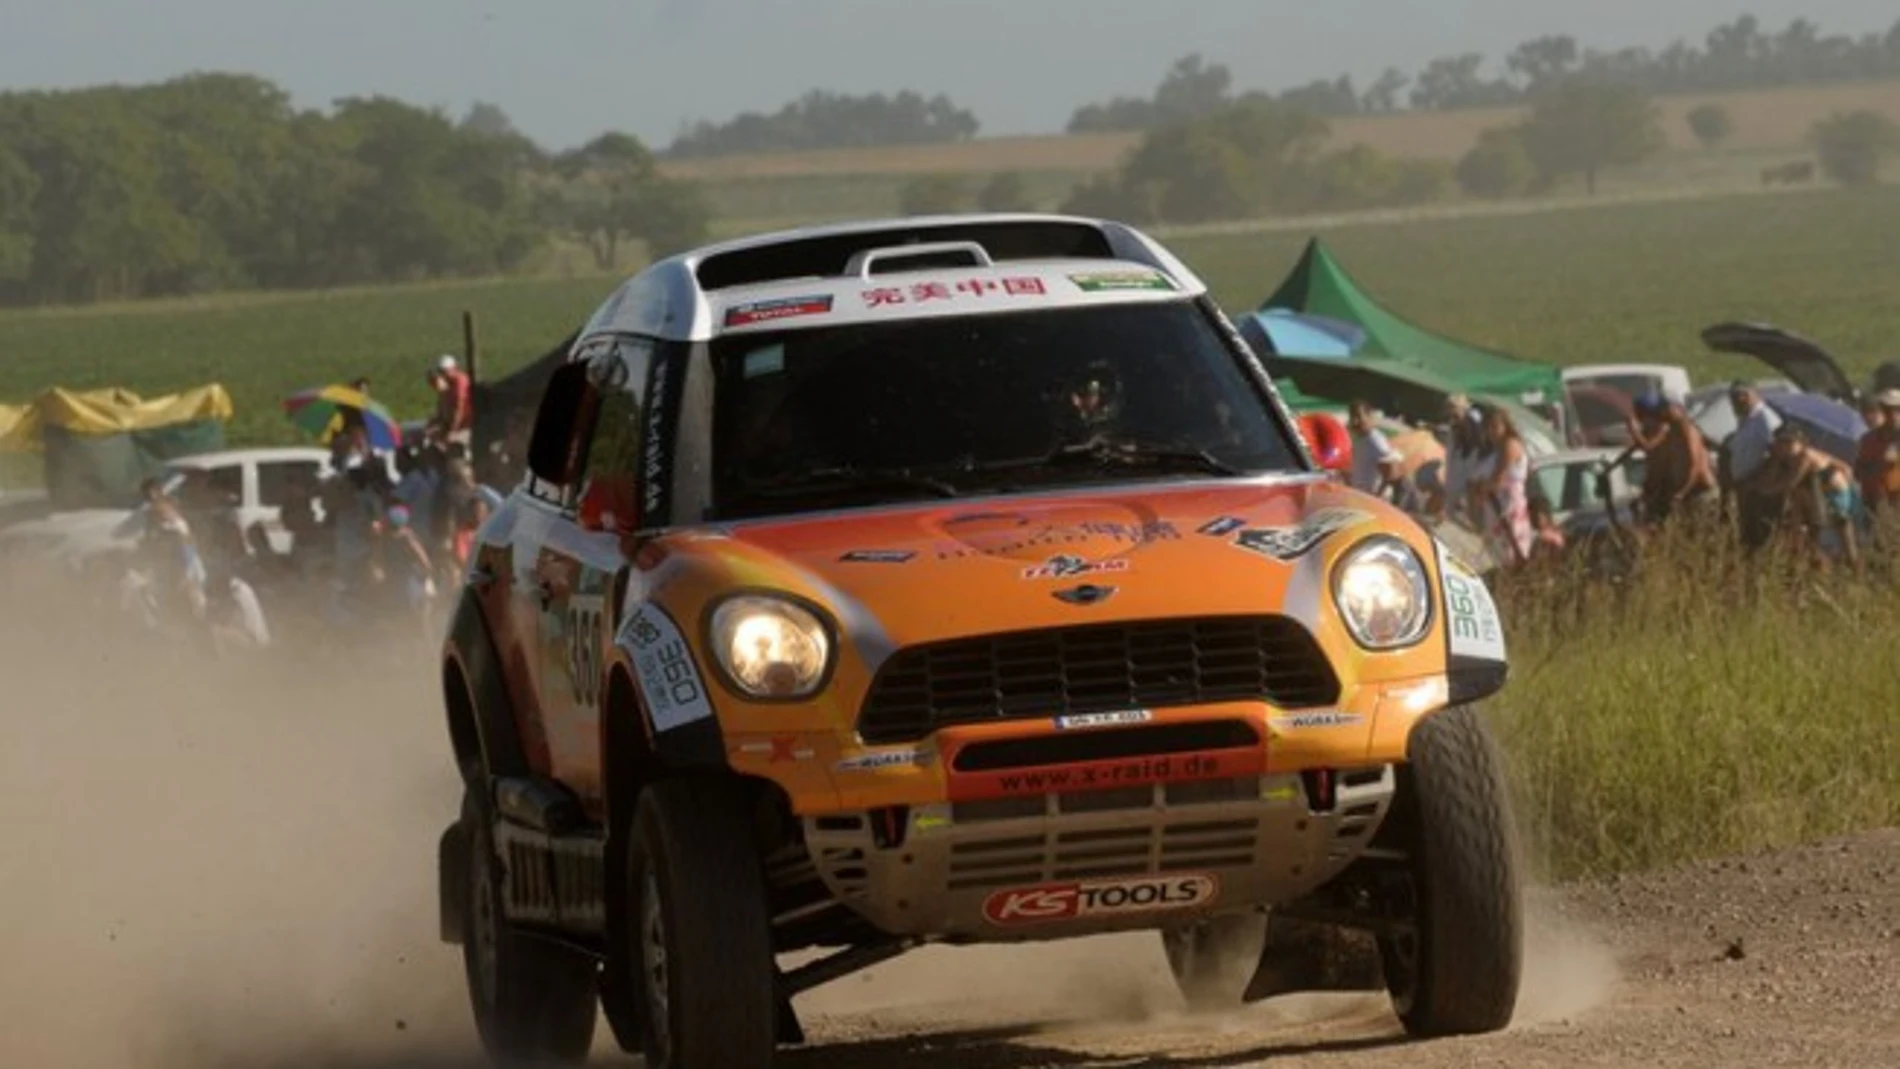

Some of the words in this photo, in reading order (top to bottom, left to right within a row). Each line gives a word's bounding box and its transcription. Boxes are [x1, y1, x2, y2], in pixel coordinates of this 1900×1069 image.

[861, 277, 1047, 308] 完美中国
[1446, 573, 1479, 640] 360
[656, 640, 699, 706] 360
[1000, 754, 1218, 791] www.x-raid.de
[999, 888, 1079, 919] KS
[1079, 879, 1198, 909] TOOLS
